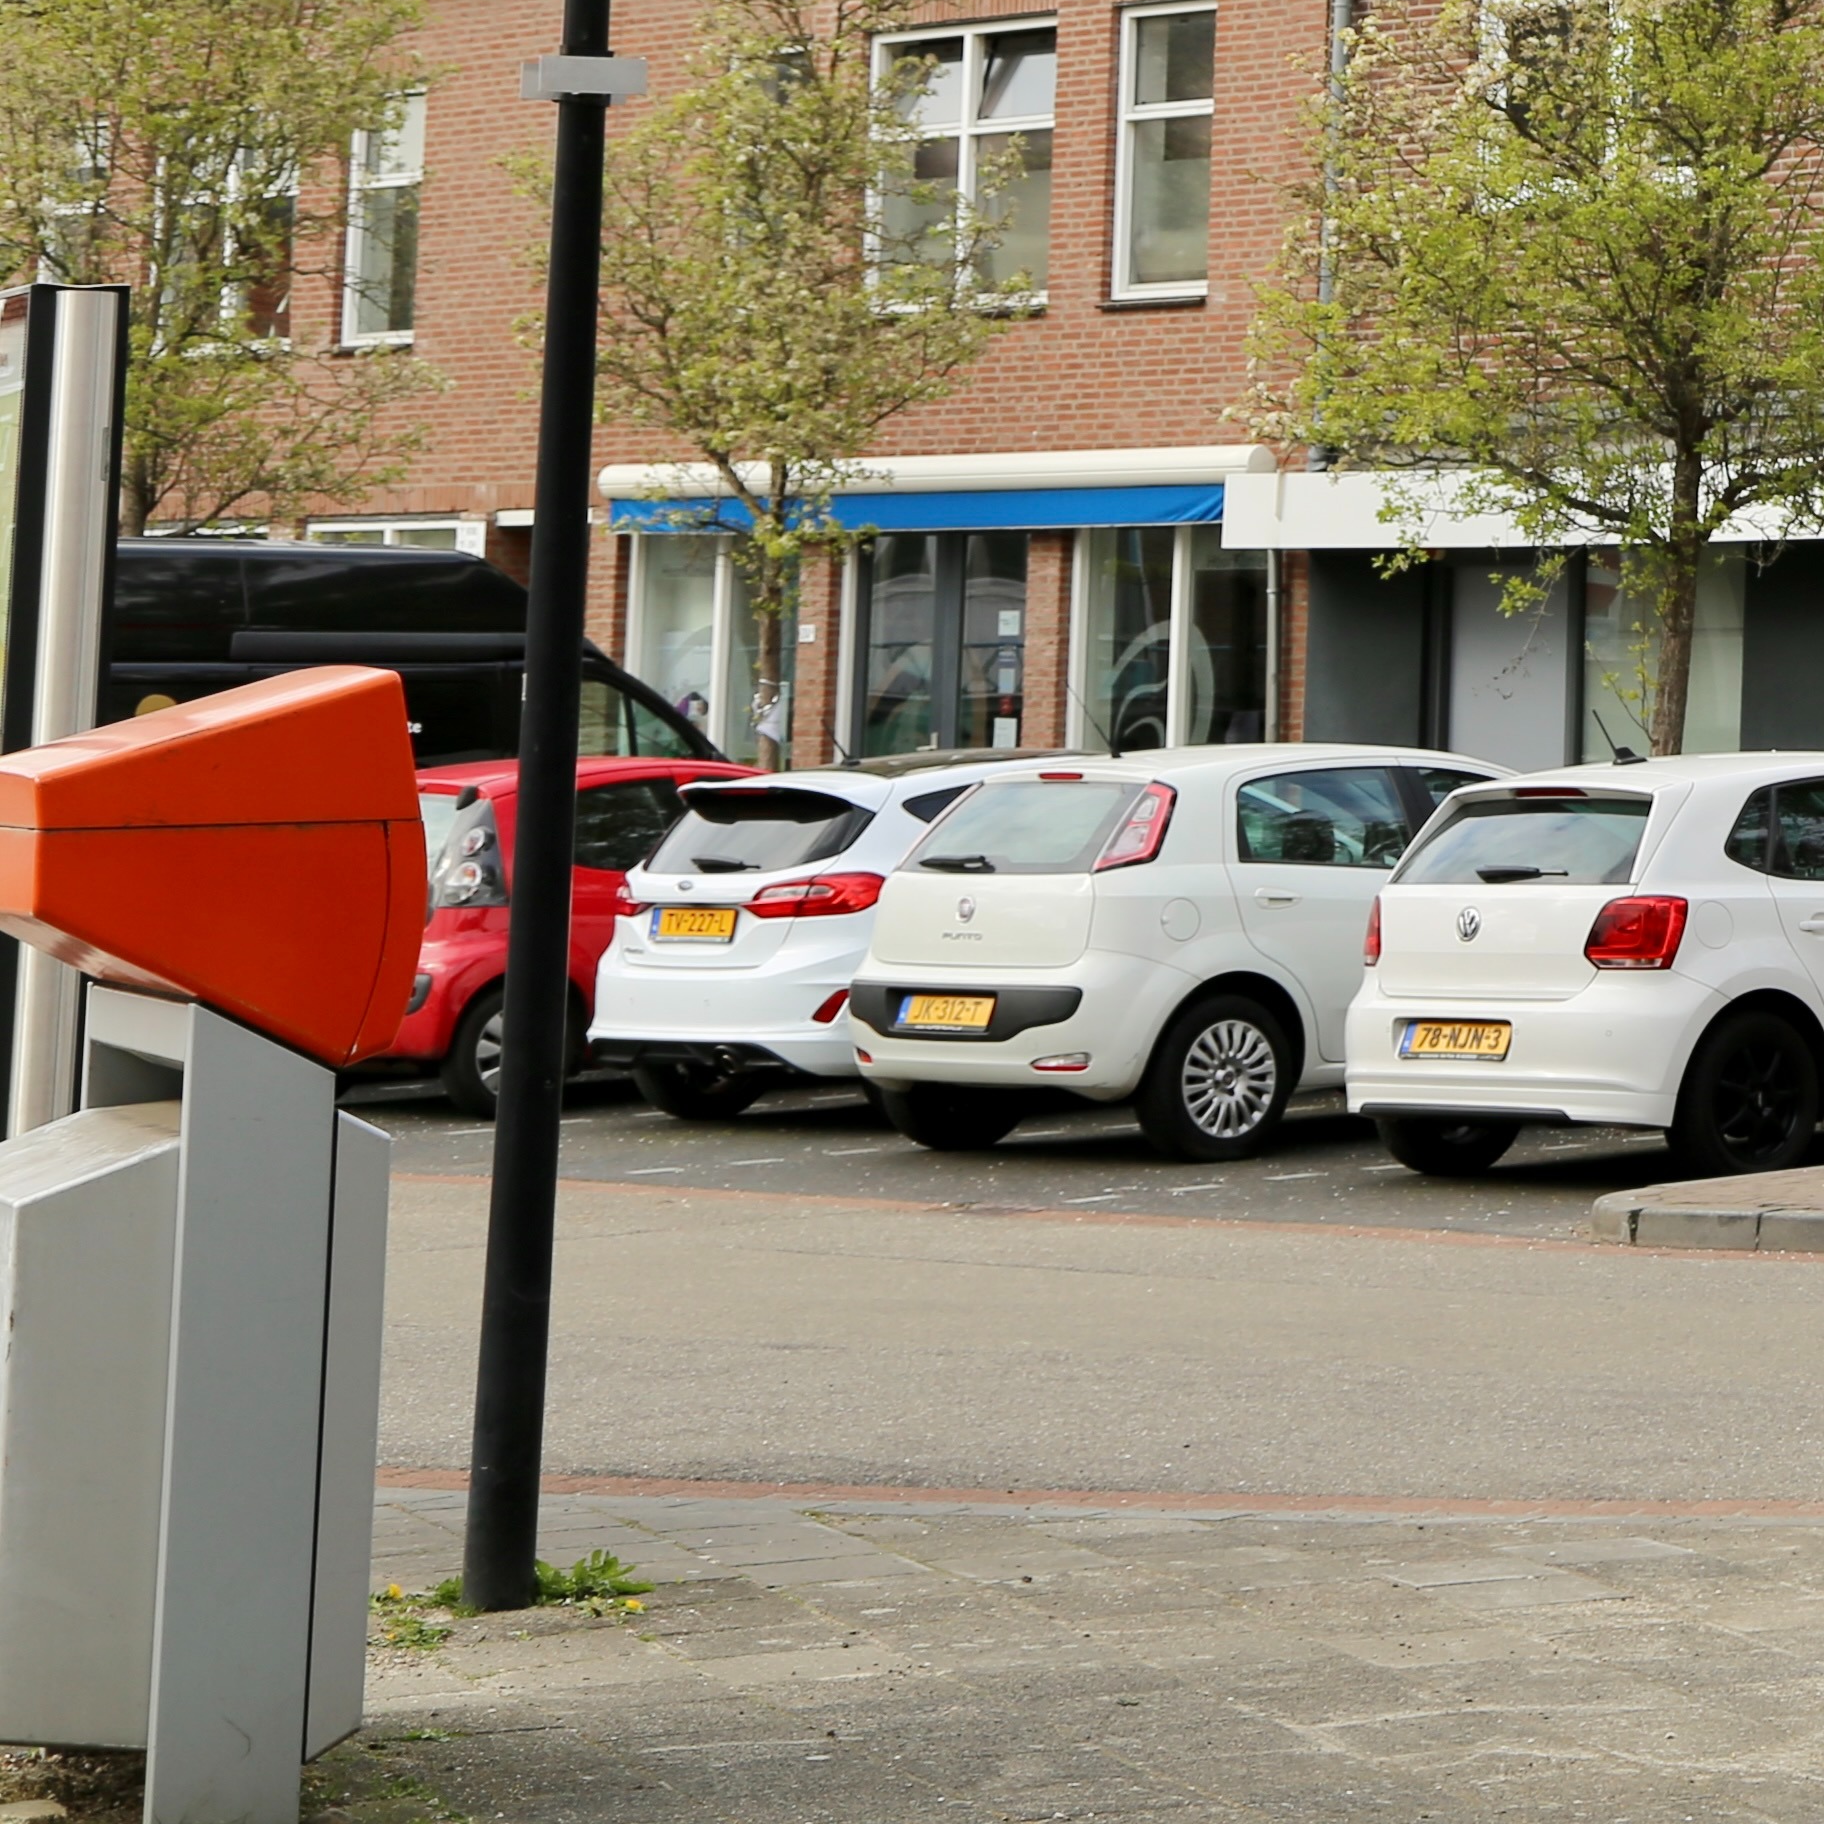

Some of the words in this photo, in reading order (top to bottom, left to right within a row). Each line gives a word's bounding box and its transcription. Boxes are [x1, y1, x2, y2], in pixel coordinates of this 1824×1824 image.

[667, 913, 726, 932] TV-227-L
[942, 932, 983, 942] PUNTO
[913, 1000, 983, 1022] JK-312-T
[1417, 1027, 1502, 1050] 78-NJN-3
